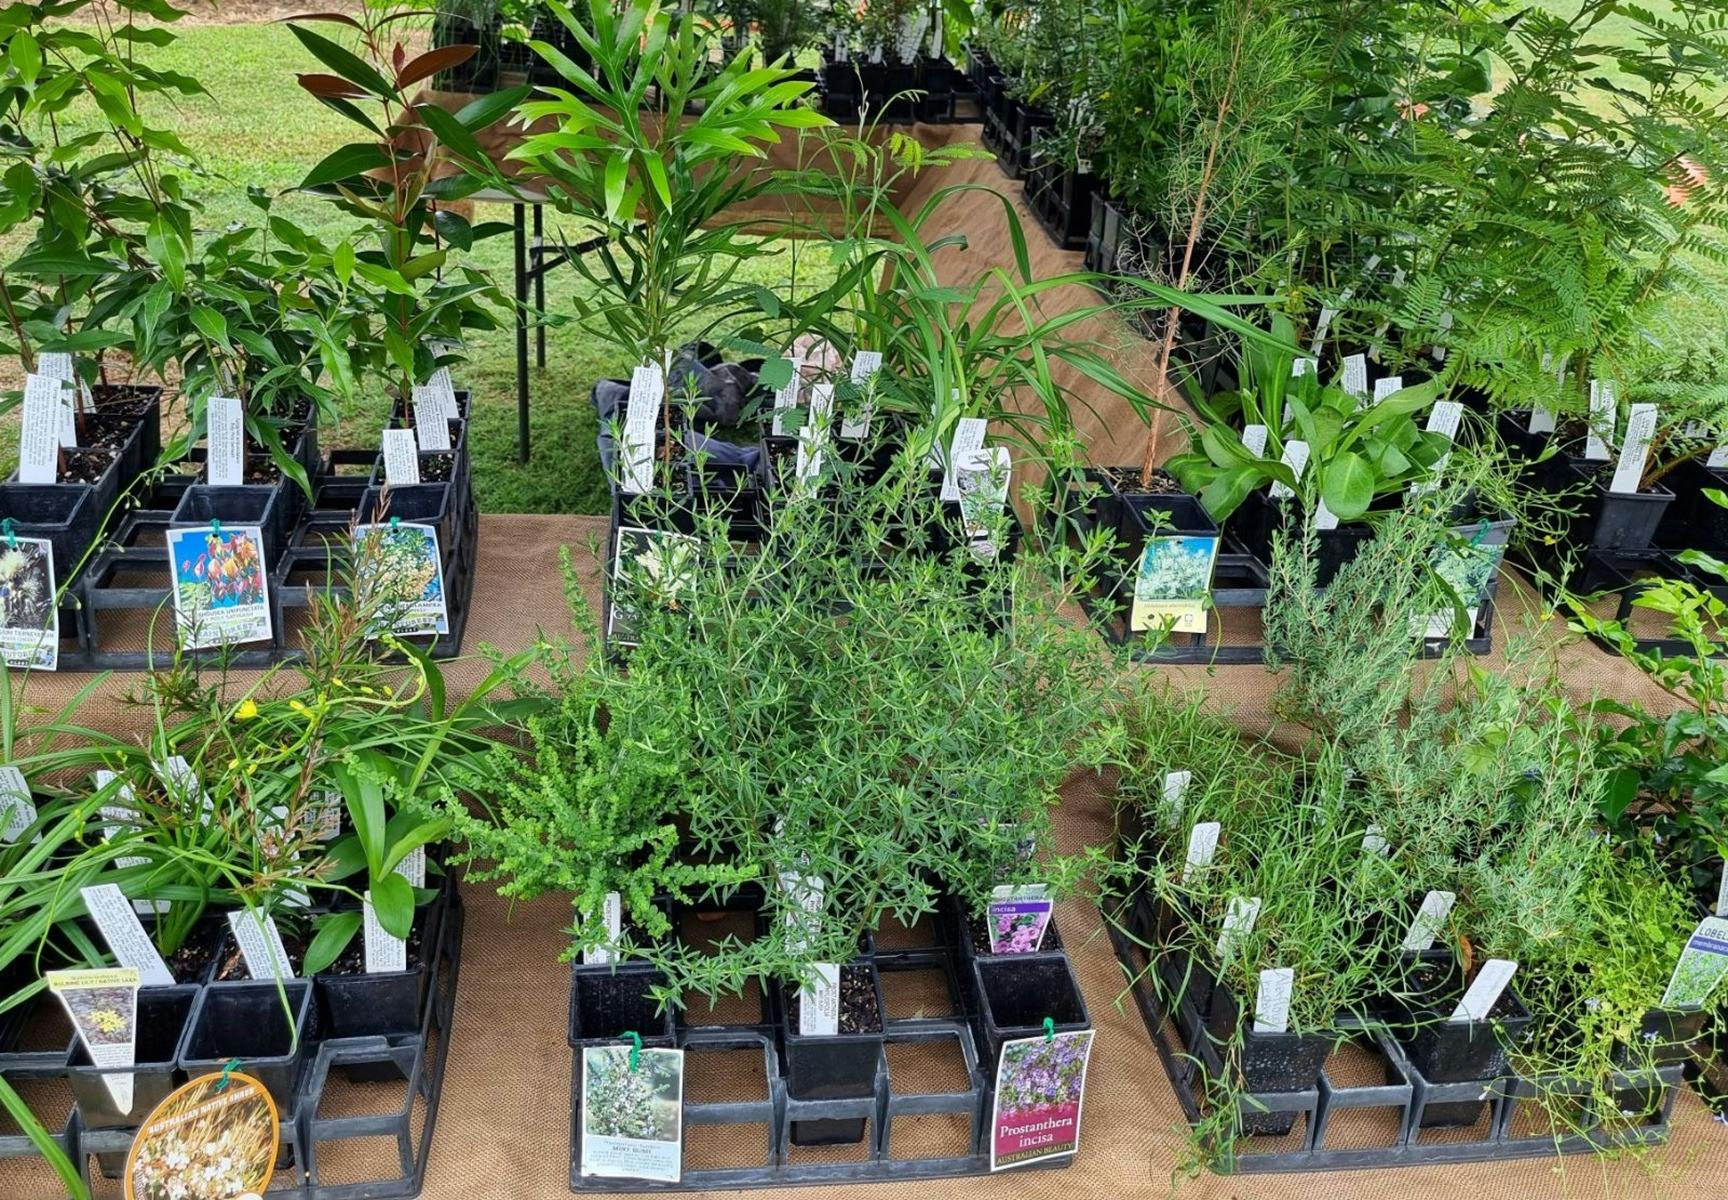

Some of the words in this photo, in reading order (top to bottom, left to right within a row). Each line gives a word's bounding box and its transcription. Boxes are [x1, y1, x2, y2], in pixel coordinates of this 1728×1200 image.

[1000, 1117, 1073, 1138] Prostanthera
[1019, 1131, 1054, 1147] incisa
[996, 1147, 1042, 1165] AUSTRALIAN
[1043, 1142, 1074, 1155] BEAUTY
